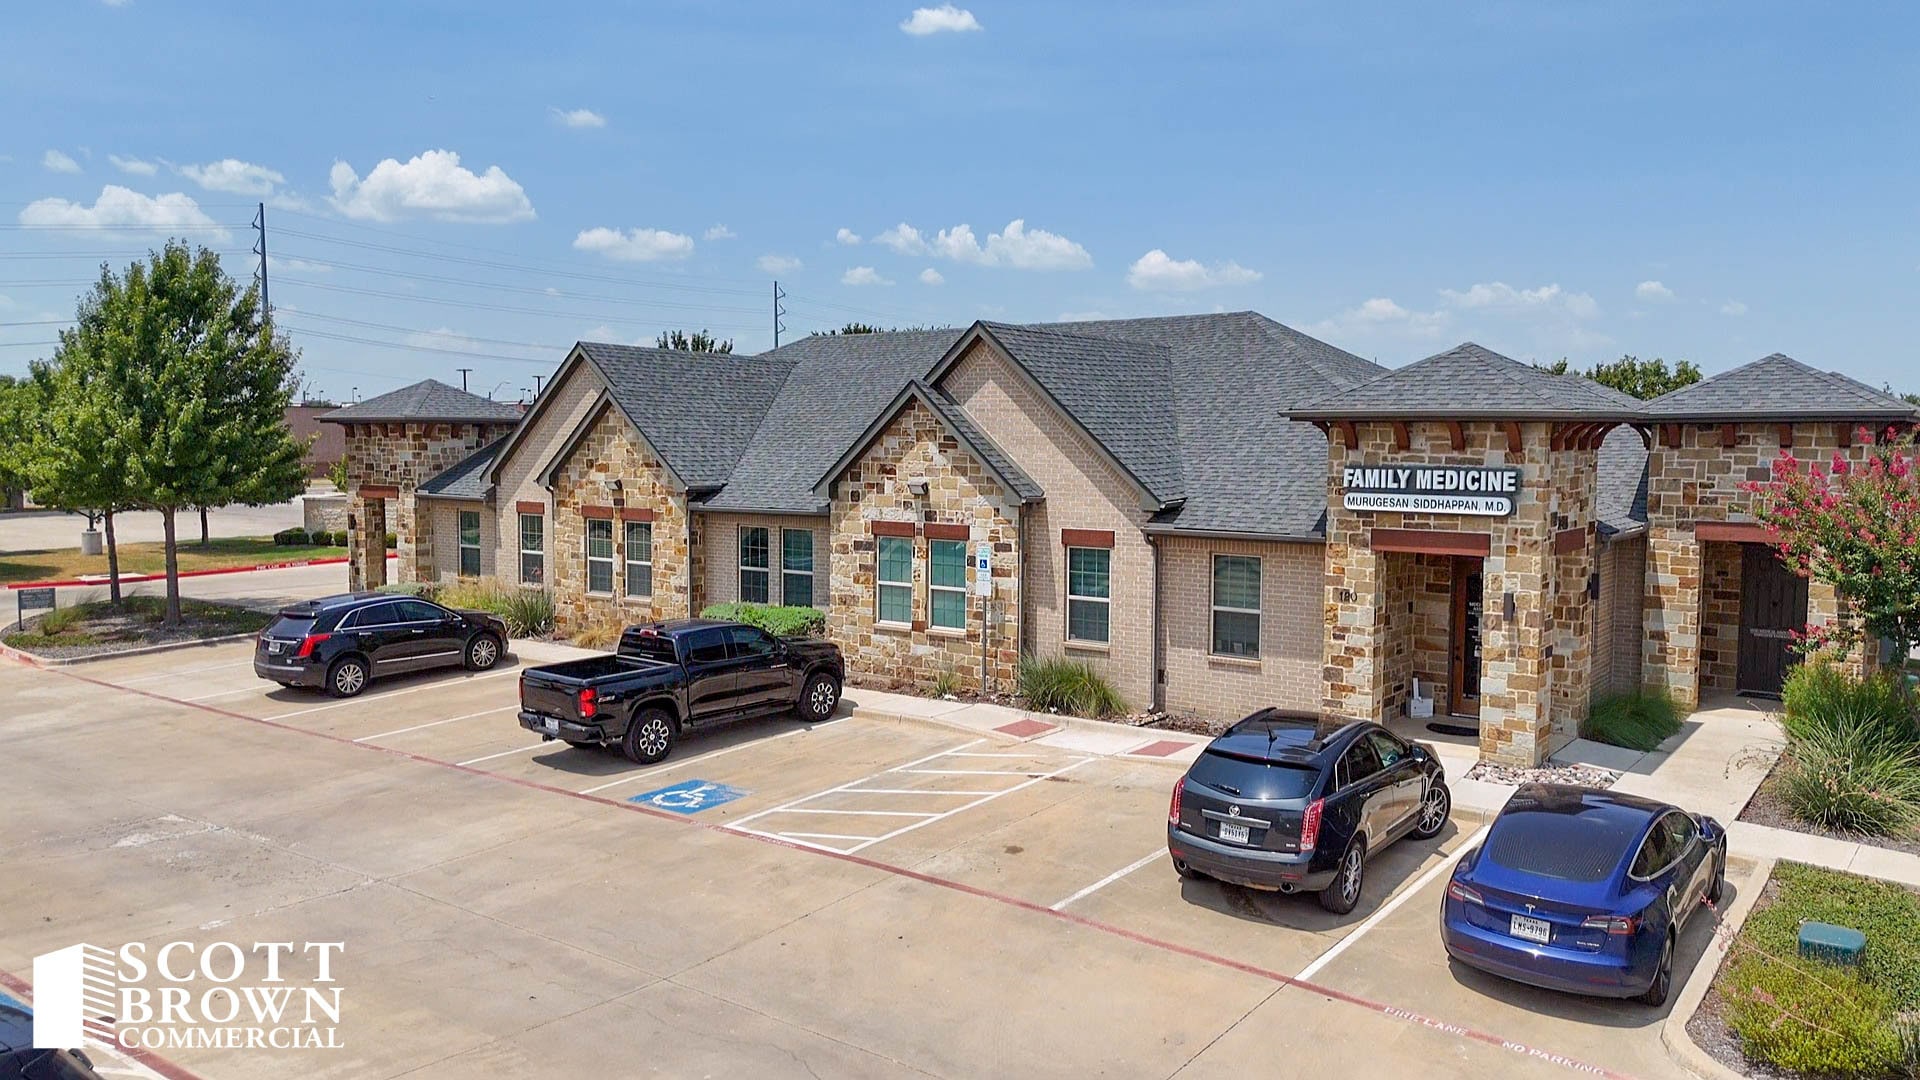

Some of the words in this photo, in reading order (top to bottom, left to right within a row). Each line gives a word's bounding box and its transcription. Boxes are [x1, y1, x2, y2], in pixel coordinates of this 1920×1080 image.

[1344, 468, 1411, 489] FAMILY
[1416, 469, 1517, 492] MEDICINE
[1347, 496, 1409, 509] MURUGESAN
[1413, 497, 1481, 512] SIDDHAPPAN,
[1485, 500, 1507, 512] M.D.
[1384, 1006, 1419, 1023] FIRE
[1424, 1018, 1468, 1037] LANE
[1503, 1040, 1526, 1053] NO
[1529, 1048, 1605, 1075] PARKING
